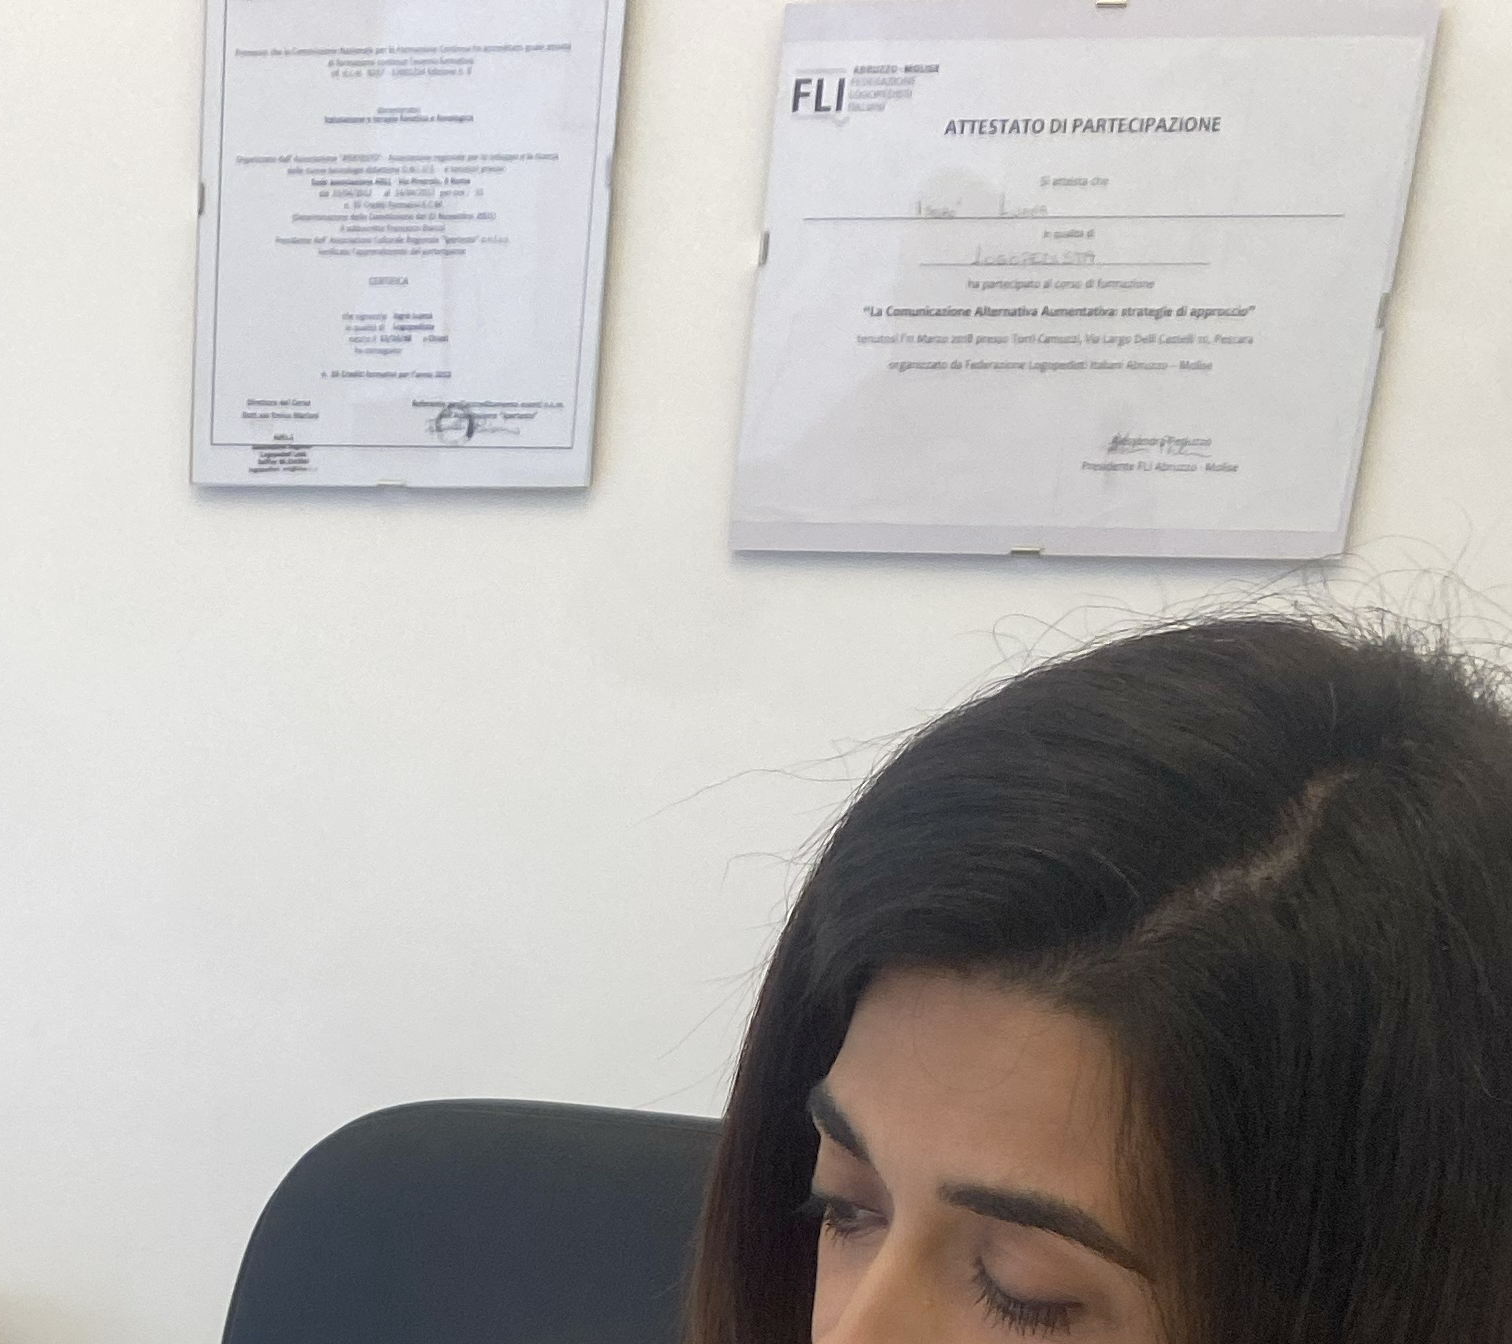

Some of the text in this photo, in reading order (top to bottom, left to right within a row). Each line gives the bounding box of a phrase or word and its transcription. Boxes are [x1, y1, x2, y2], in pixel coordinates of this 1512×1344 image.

[791, 77, 846, 113] FLI
[943, 116, 1223, 136] ATTESTATO DI PARTECIPAZIONE
